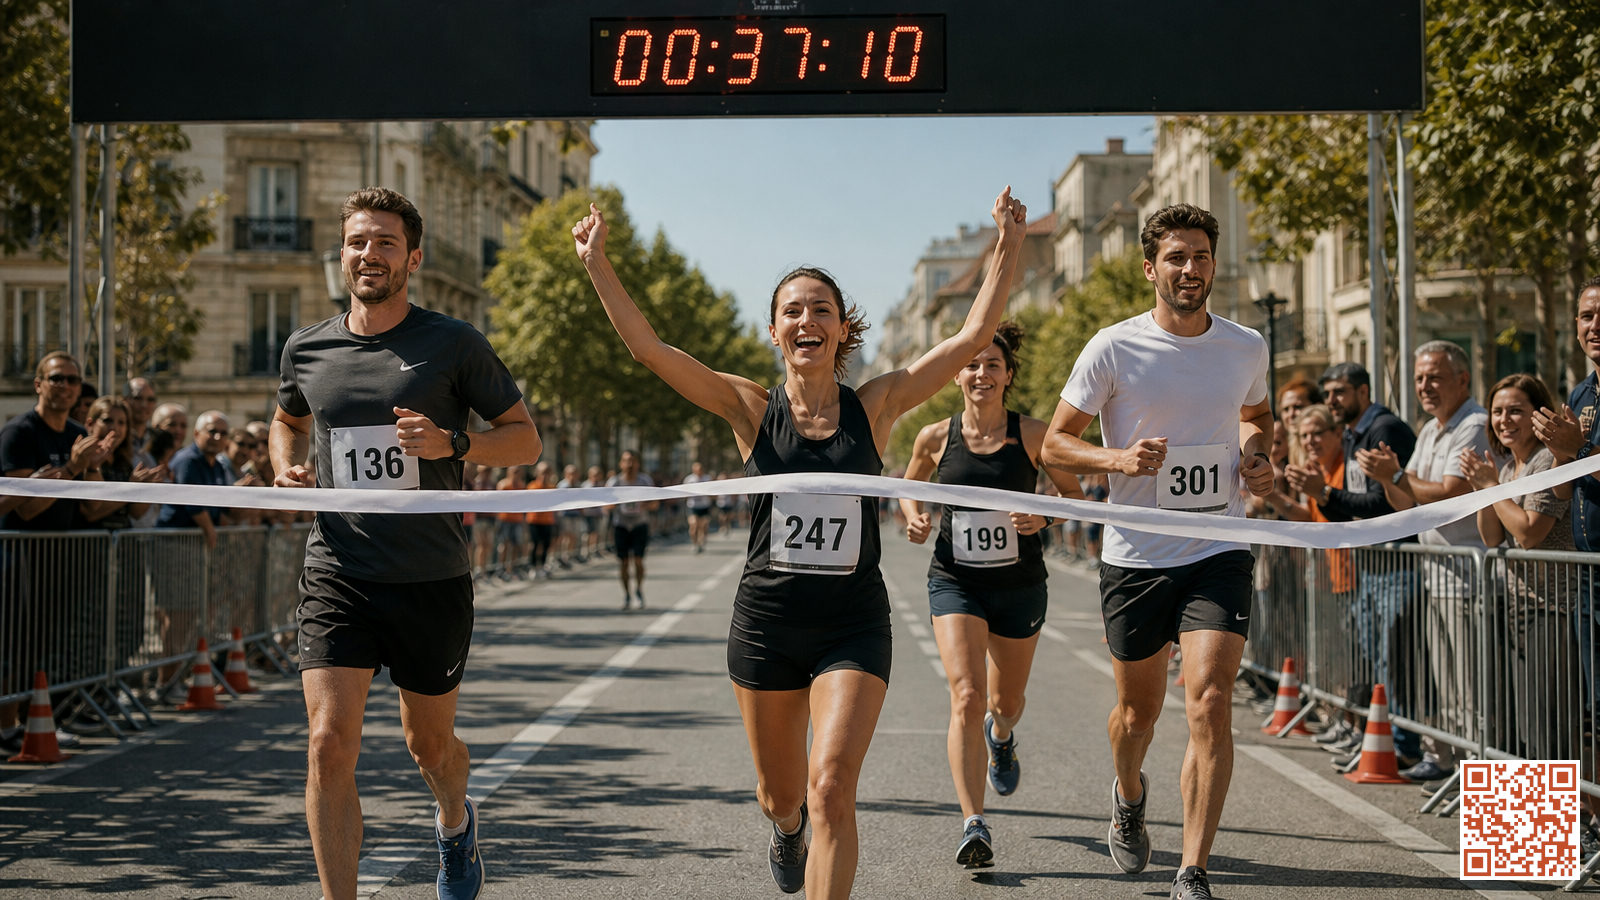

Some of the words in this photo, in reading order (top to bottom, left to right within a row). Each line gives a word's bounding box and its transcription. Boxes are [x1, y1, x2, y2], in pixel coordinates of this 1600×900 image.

[613, 26, 923, 86] 00:37:10
[345, 446, 405, 481] 136
[1170, 464, 1218, 496] 301
[785, 515, 848, 551] 247
[963, 526, 1008, 551] 199
